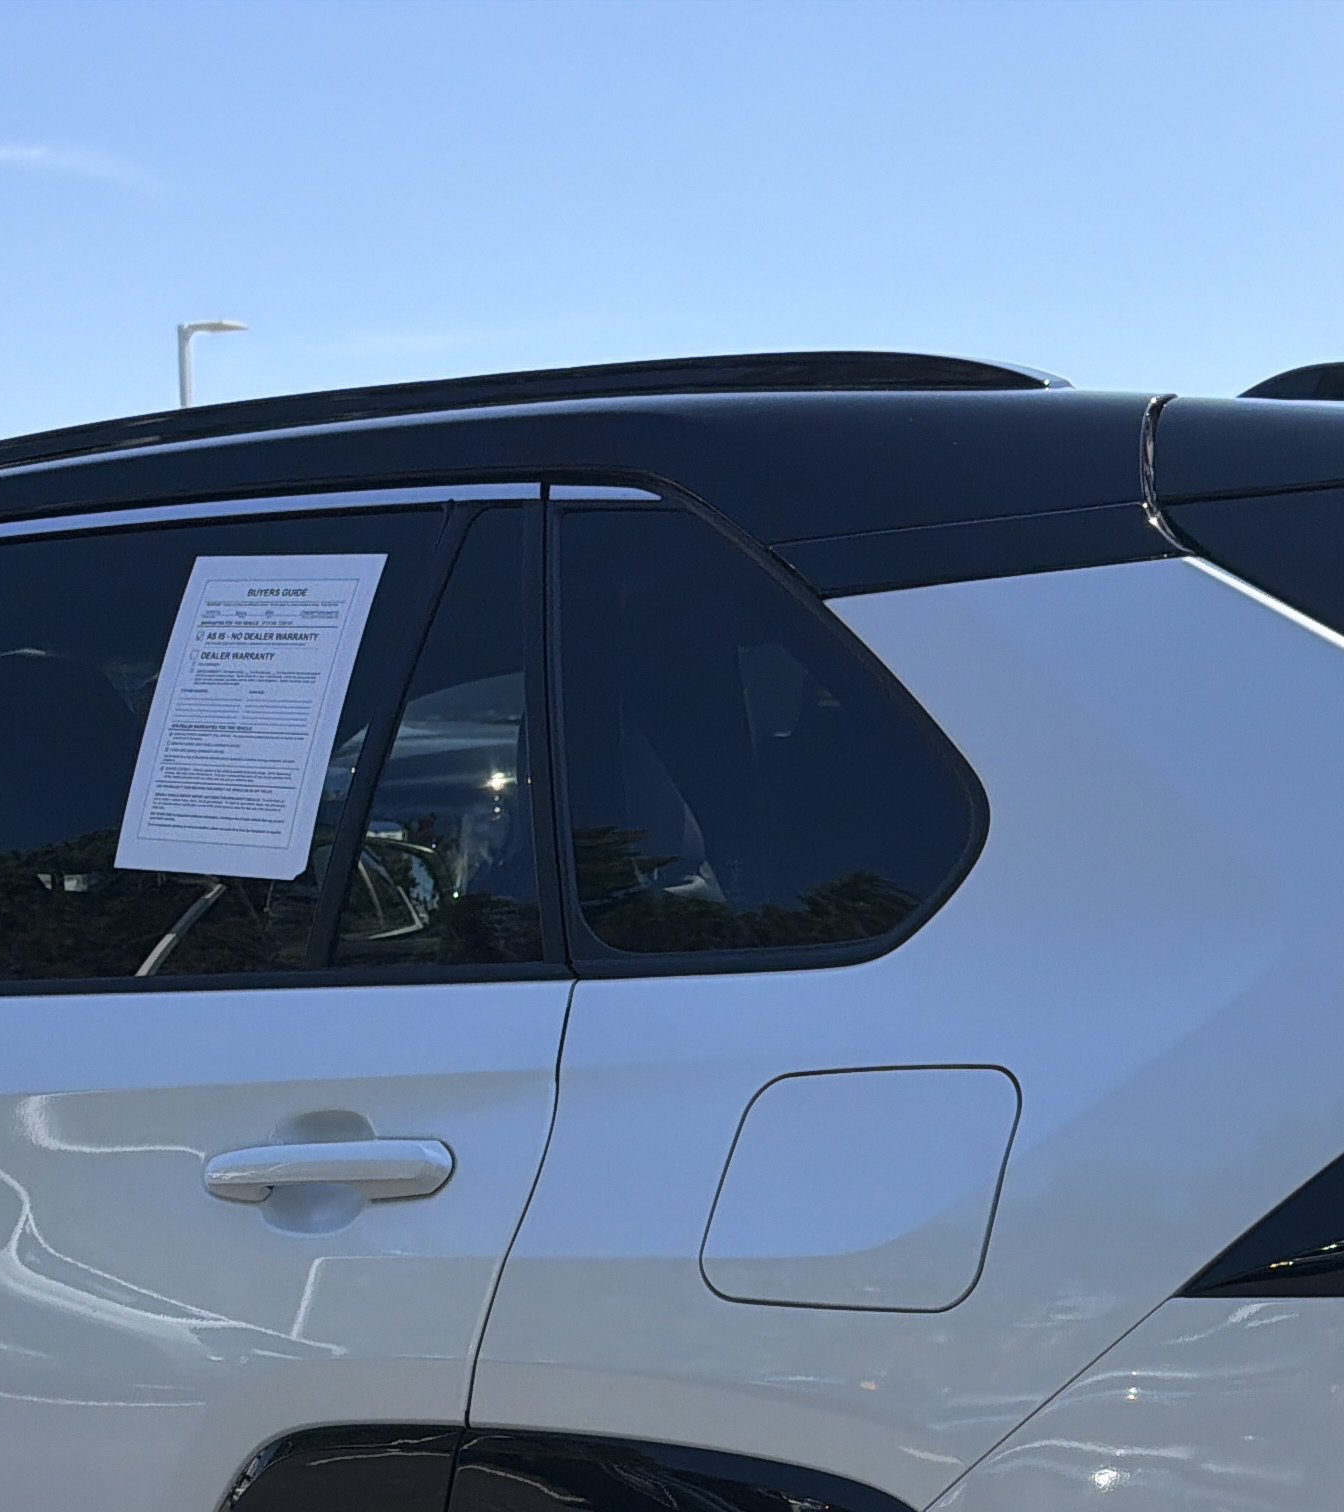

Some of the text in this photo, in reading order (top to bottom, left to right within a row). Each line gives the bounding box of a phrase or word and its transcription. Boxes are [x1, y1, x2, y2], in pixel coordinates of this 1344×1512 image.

[247, 588, 308, 597] BUYERS GUIDE
[207, 632, 217, 641] AS
[218, 632, 225, 641] IS
[231, 632, 243, 641] NO
[244, 632, 274, 641] DEALER
[275, 633, 319, 641] WARRANTY
[201, 652, 275, 661] DEALER WARRANTY
